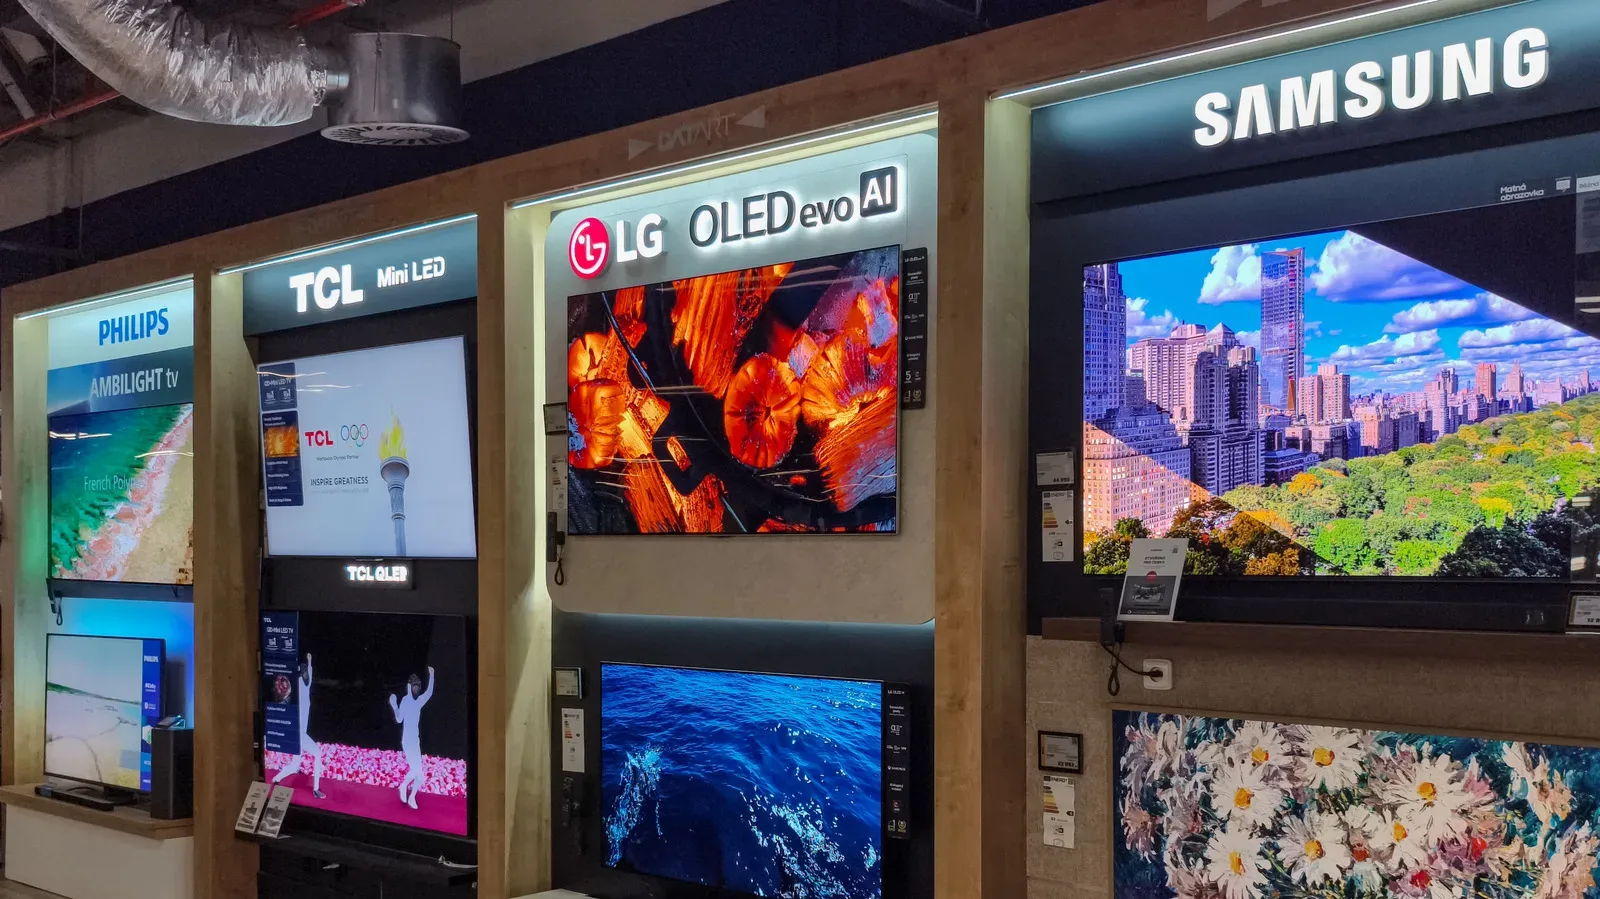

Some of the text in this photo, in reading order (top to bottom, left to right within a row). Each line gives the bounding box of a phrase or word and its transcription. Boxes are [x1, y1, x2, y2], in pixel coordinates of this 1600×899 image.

[1194, 27, 1550, 148] SAMSUNG
[1500, 189, 1545, 202] obrazovka
[616, 171, 894, 263] LG OLED evo AI
[289, 256, 446, 312] TCL Mini LED
[98, 307, 170, 347] PHILIPS
[90, 367, 179, 398] AMBILIGHT tv
[304, 430, 334, 447] TCL
[84, 474, 111, 492] French
[310, 476, 369, 487] INSPIRE GREATNESS
[346, 565, 374, 581] TCL
